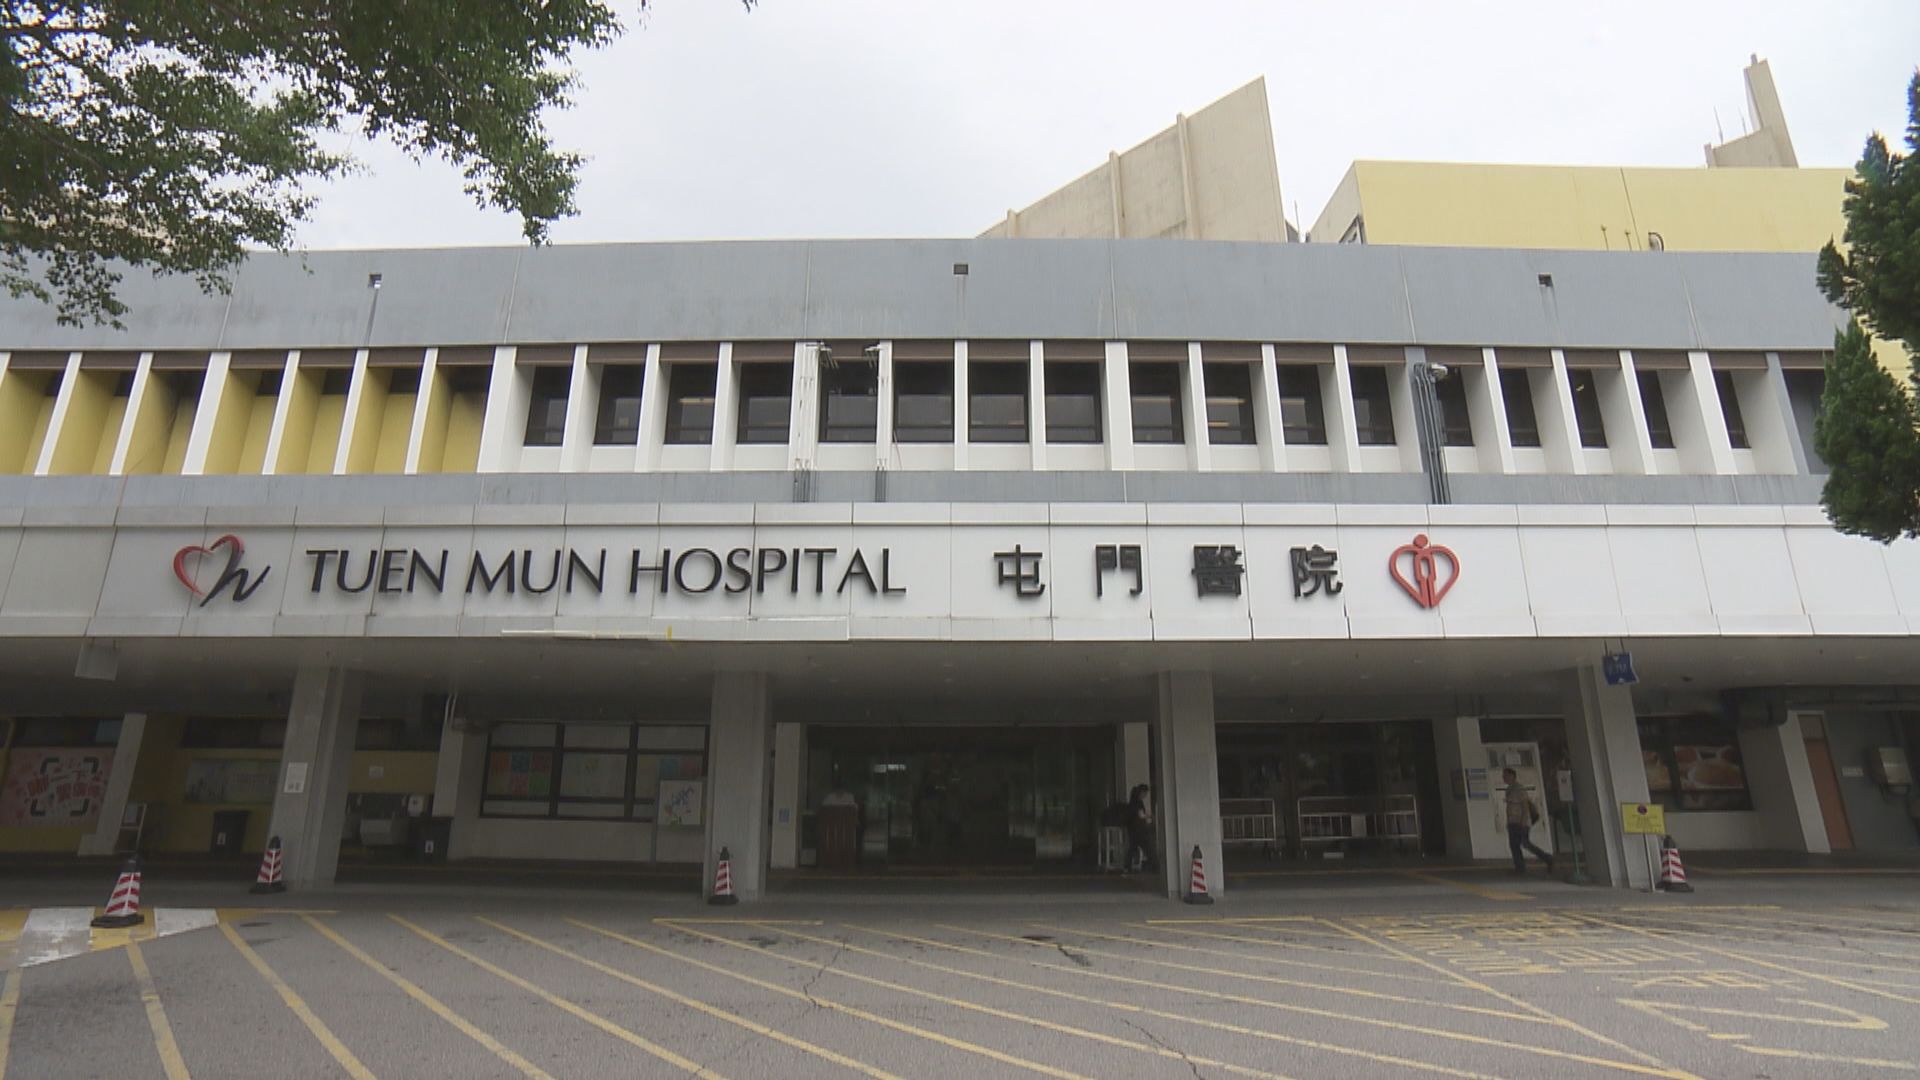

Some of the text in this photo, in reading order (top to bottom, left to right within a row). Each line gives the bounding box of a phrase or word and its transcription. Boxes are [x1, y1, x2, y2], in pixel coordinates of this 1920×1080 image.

[305, 548, 907, 597] TUEN MUN HOSPITAL
[994, 544, 1343, 599] 屯門醫院
